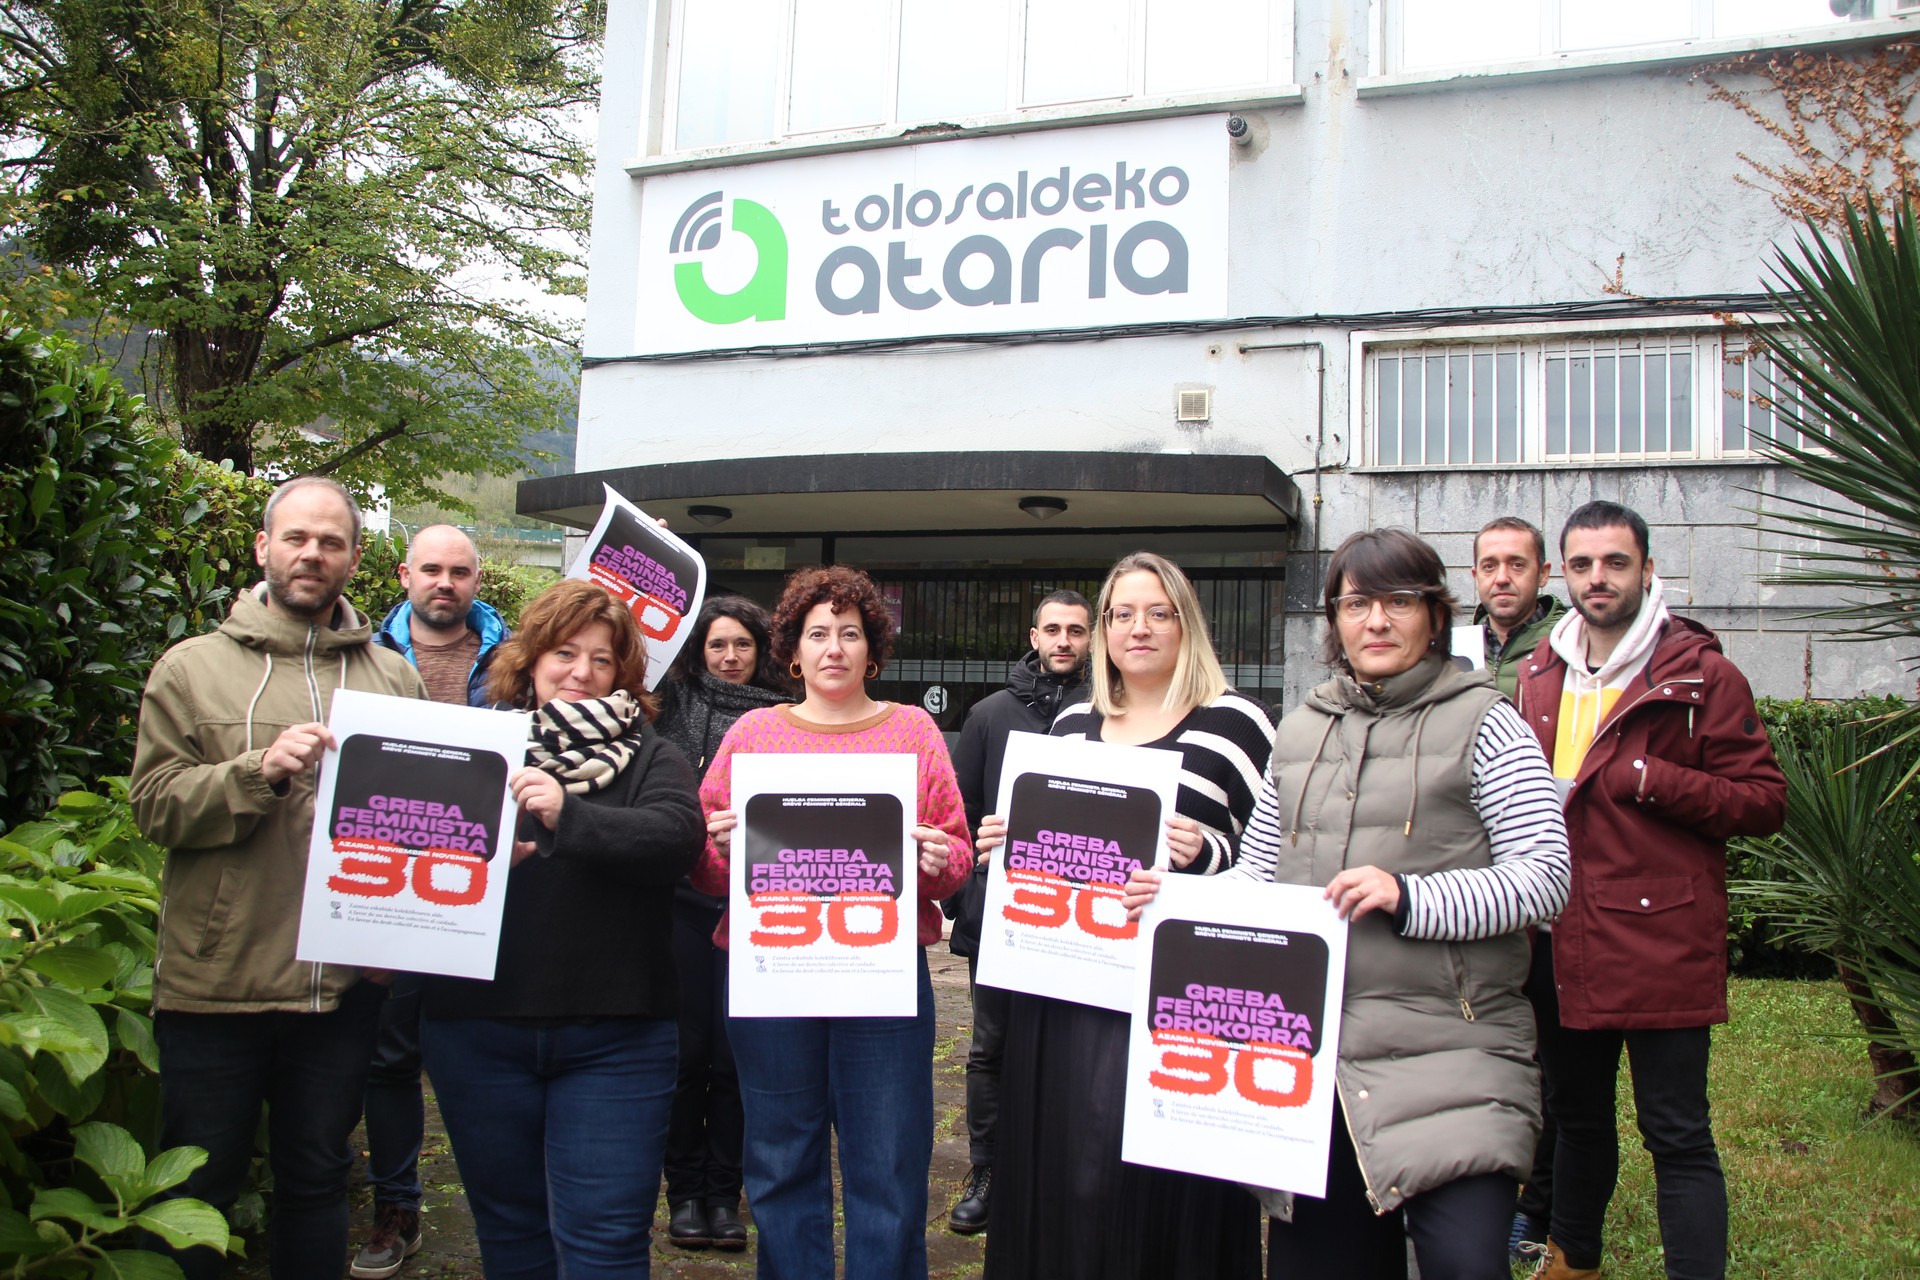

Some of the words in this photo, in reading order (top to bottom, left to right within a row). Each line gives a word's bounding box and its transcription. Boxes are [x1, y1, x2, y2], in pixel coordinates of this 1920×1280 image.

[822, 161, 1190, 236] tolosaldeko
[815, 220, 1190, 316] ataria
[600, 544, 687, 602] FEMINISTA
[622, 544, 676, 584] GREBA
[594, 554, 685, 611] OROKORRA
[338, 806, 489, 838] FEMINISTA
[368, 794, 465, 820] GREBA
[335, 821, 489, 854] OROKORRA
[338, 840, 375, 850] AZAROA
[378, 845, 430, 857] NOVIEMBRE
[432, 851, 482, 863] NOVEMBRE
[1036, 829, 1122, 855] GREBA
[327, 835, 489, 908] 30
[752, 864, 893, 877] FEMINISTA
[778, 848, 868, 862] GREBA
[1008, 854, 1129, 887] OROKORR
[1011, 840, 1144, 874] FEMINISTA
[751, 878, 895, 892] OROKORRA
[1011, 872, 1043, 882] AZAROA
[1045, 877, 1091, 890] NOVIEMBRE
[749, 890, 898, 949] 30
[1185, 982, 1285, 1011] GREBA
[1156, 996, 1313, 1031] FEMINISTA
[1153, 1012, 1313, 1049] OROKORRA
[1158, 1032, 1194, 1044] AZAROA
[1197, 1038, 1251, 1051] NOVIEMBRE
[1253, 1045, 1307, 1059] NOVEMBRE
[1149, 1026, 1314, 1109] 30
